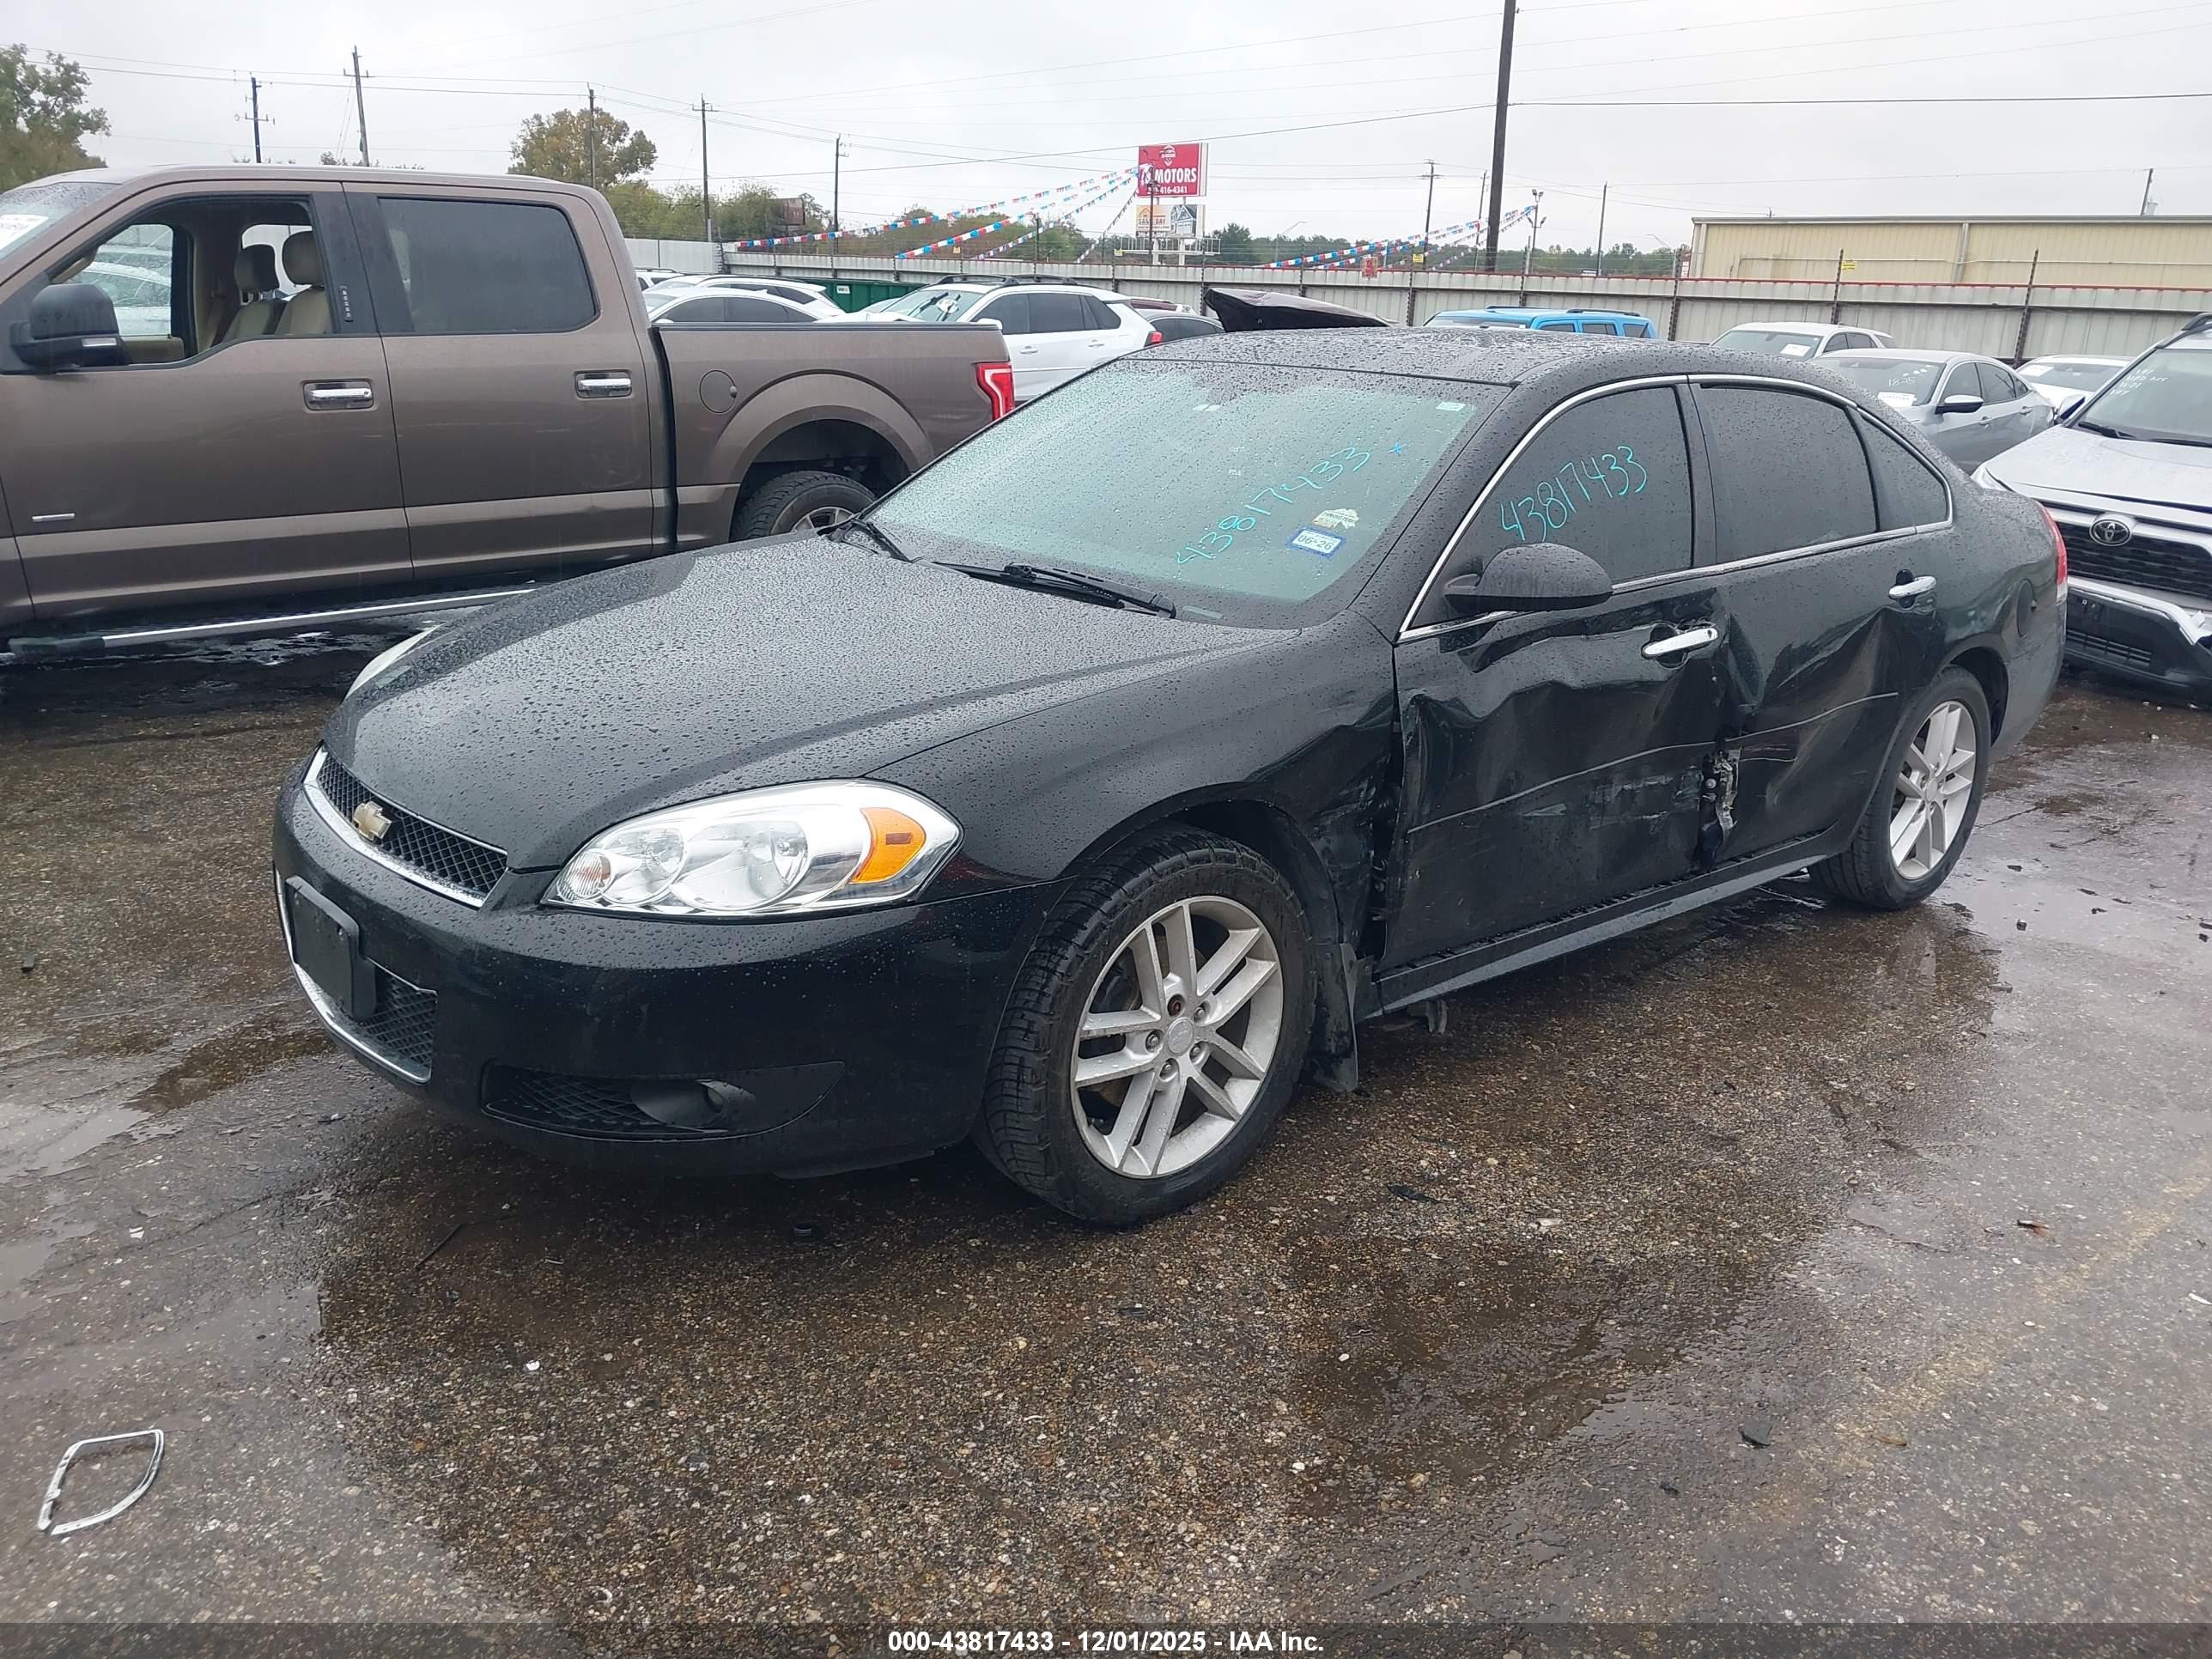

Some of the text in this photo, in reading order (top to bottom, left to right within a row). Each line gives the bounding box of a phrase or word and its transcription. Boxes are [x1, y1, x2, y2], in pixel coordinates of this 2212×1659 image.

[1155, 167, 1197, 183] MOTORS
[1176, 447, 1371, 564] 43817433
[1500, 446, 1647, 543] 43817433
